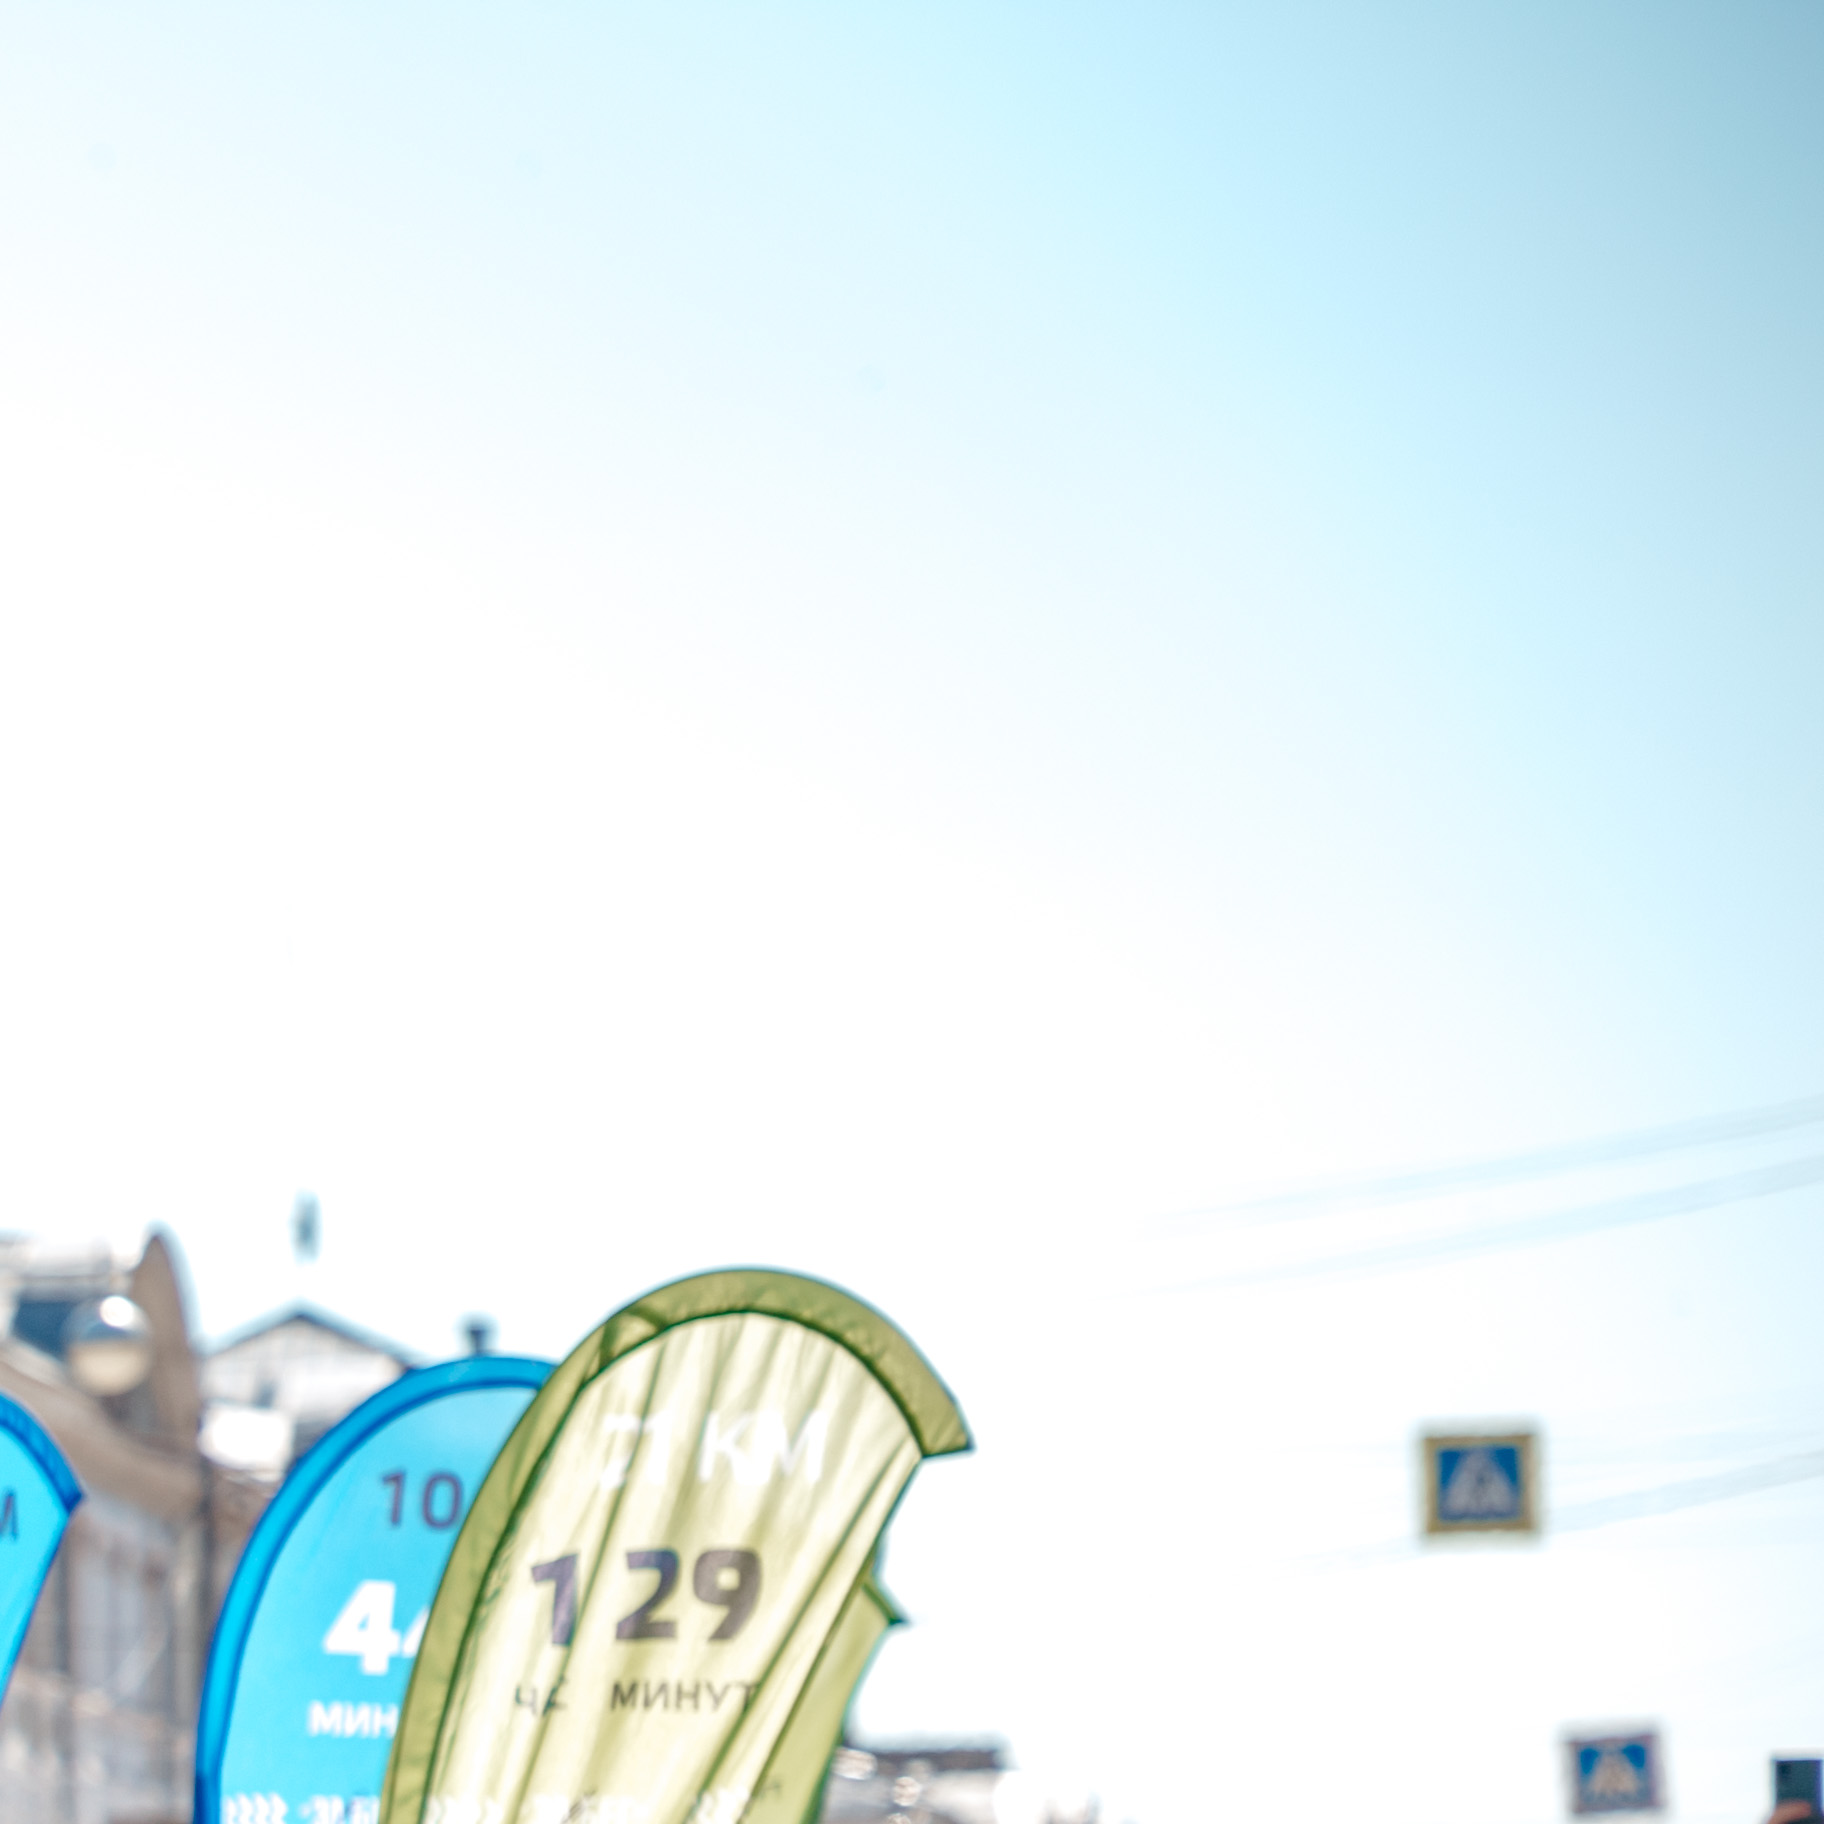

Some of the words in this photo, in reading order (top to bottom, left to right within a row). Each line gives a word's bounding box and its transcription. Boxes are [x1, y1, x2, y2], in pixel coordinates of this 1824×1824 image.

[698, 1405, 829, 1486] КМ
[382, 1468, 464, 1531] 10
[530, 1552, 581, 1648] 1
[614, 1548, 764, 1643] 29
[309, 1701, 399, 1738] МИН
[609, 1676, 758, 1714] МИНУТ
